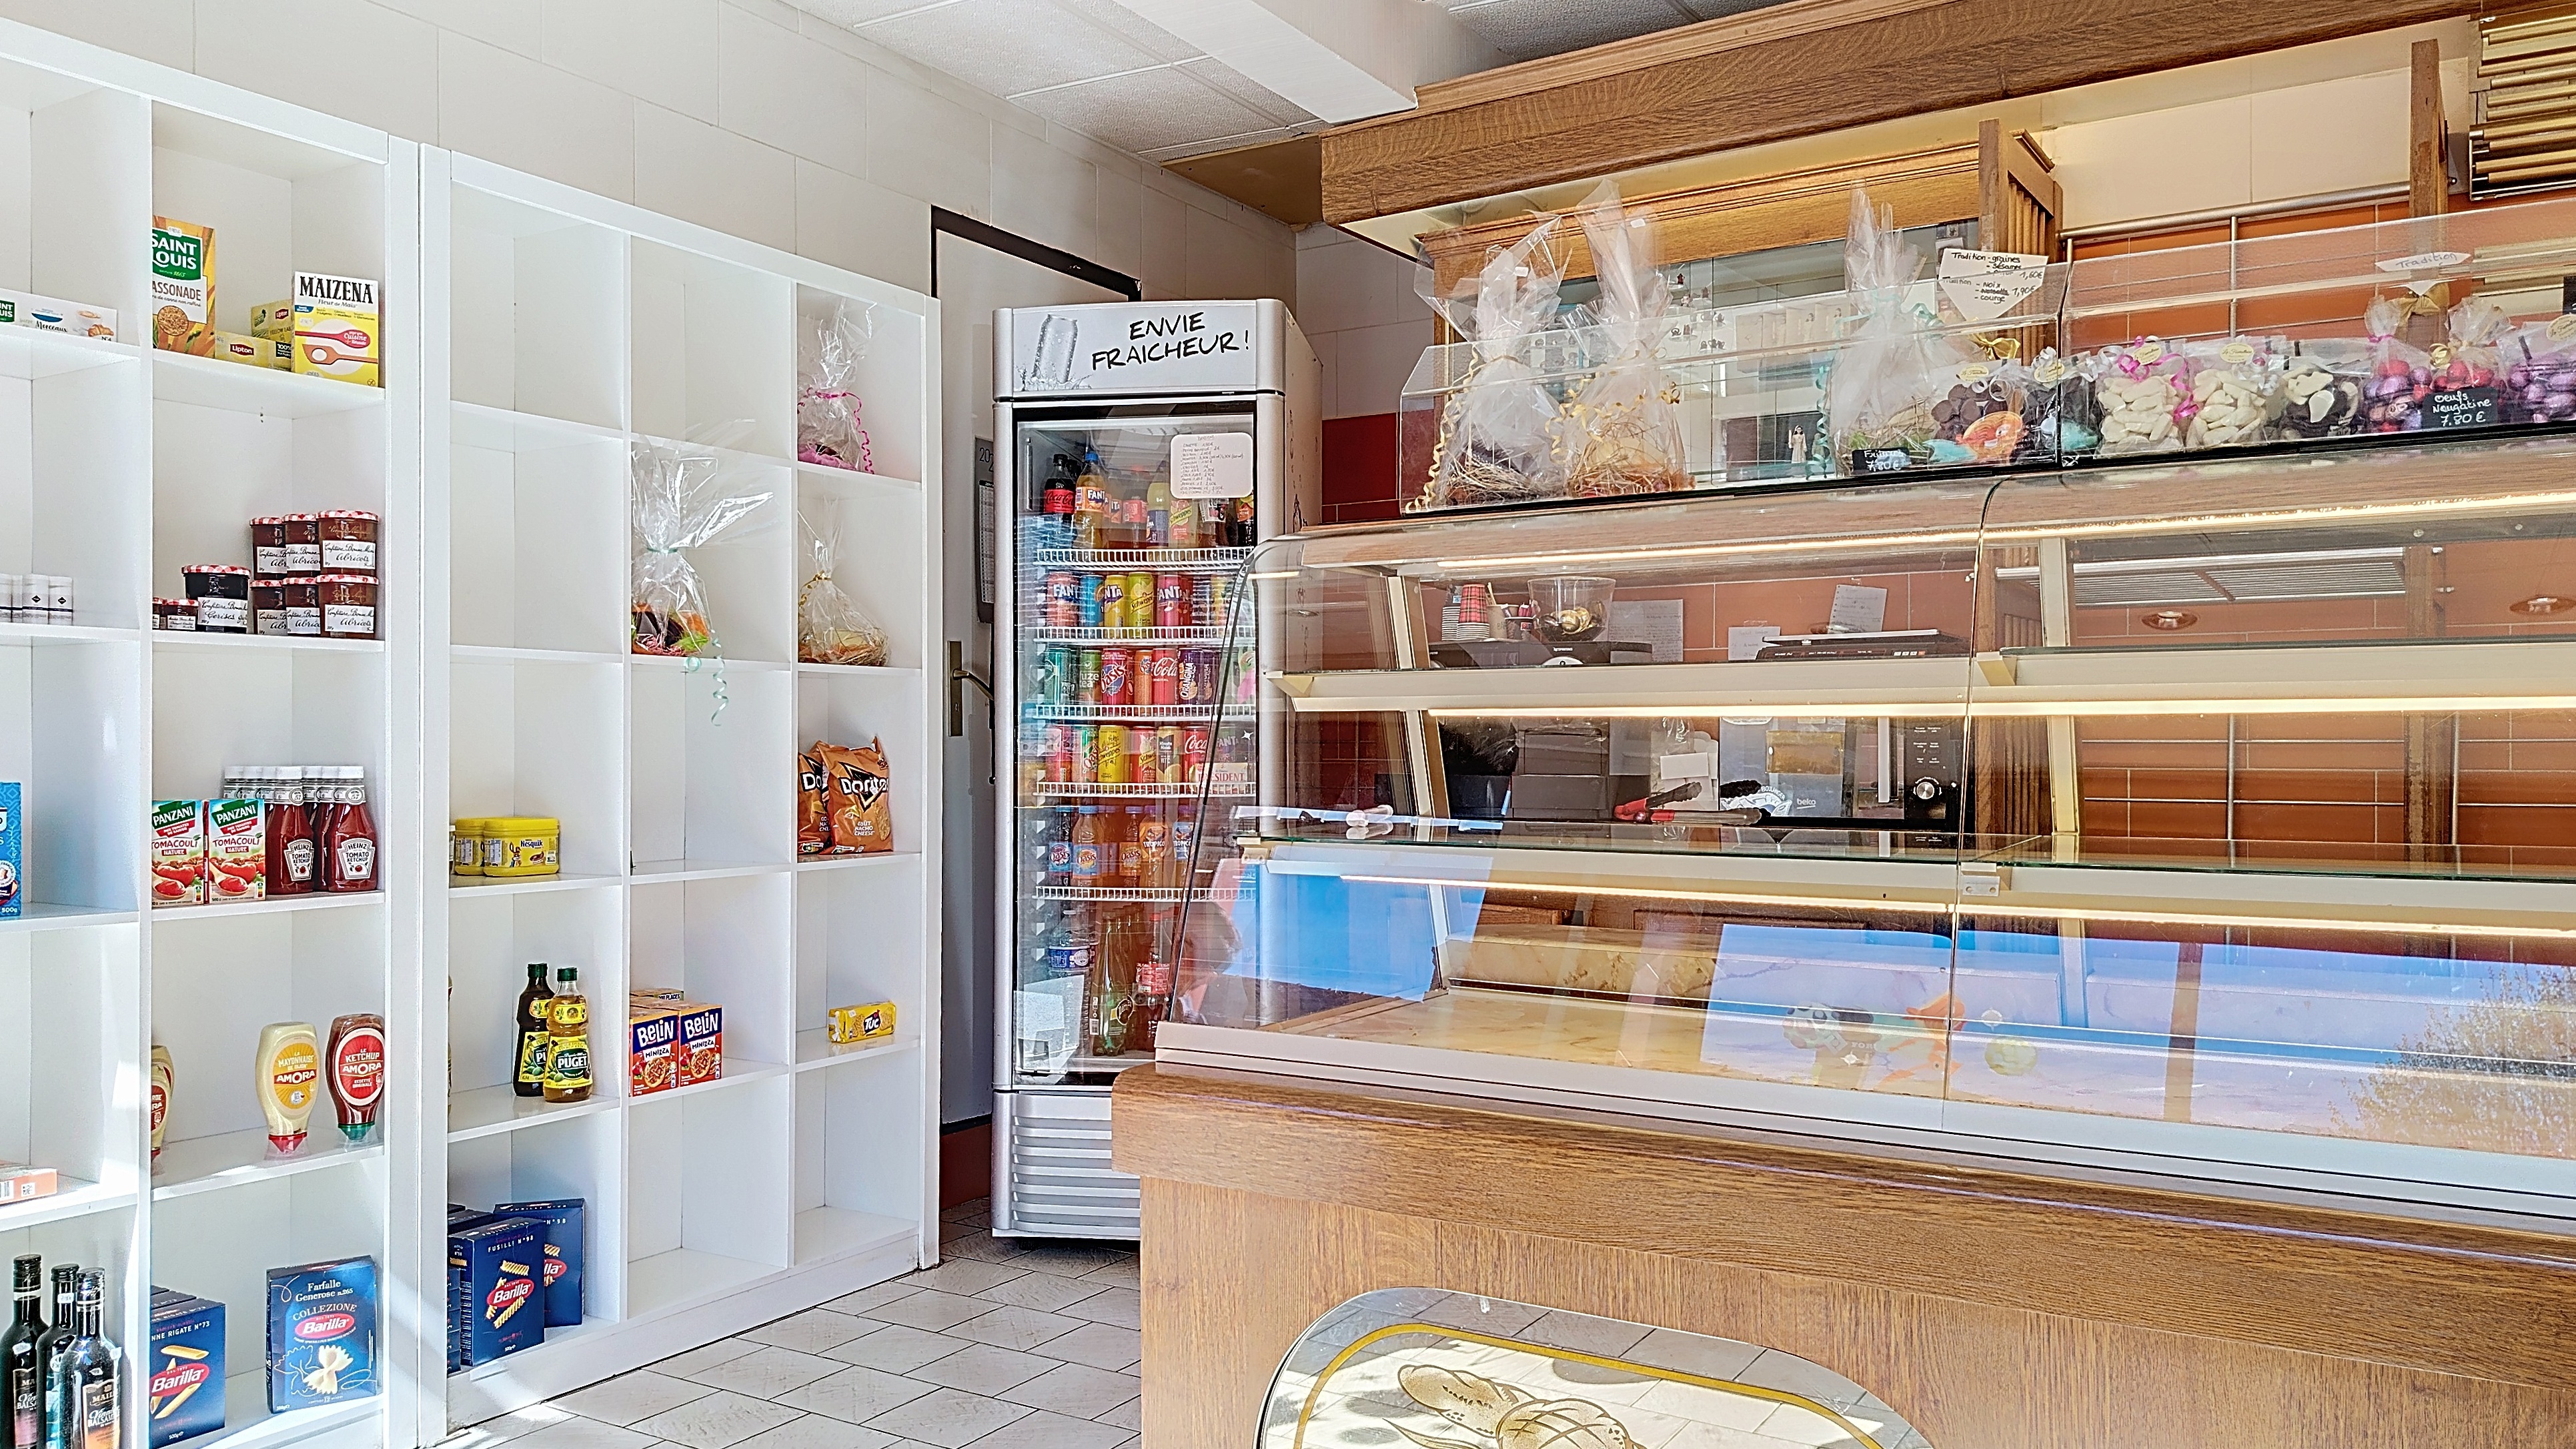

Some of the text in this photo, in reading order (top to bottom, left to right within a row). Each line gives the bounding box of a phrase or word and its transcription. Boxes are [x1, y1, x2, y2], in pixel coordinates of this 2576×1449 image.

[1951, 252, 1986, 260] Tradition
[2396, 253, 2457, 268] Tradition
[299, 276, 374, 304] MAIZENA
[1130, 312, 1205, 340] ENVIE
[232, 346, 252, 355] Lipton
[1092, 332, 1240, 370] FRAICHEUR
[153, 806, 193, 827] PANZANI
[217, 805, 256, 825] PANZANI
[213, 838, 259, 847] TOMACOULI
[521, 840, 543, 848] Nesquik
[692, 1039, 714, 1049] MINIZZA
[346, 1052, 380, 1063] KETCHUP
[645, 1047, 670, 1058] MINIZZA
[278, 1055, 314, 1067] MAYONNAISE
[558, 1056, 587, 1068] PUGET
[342, 1062, 382, 1075] AMORA
[276, 1070, 315, 1083] AMORA
[488, 1240, 514, 1253] FUSILLI
[307, 1280, 341, 1292] Farfalle
[295, 1290, 336, 1302] Generose
[494, 1284, 528, 1304] Barilla
[293, 1303, 357, 1321] COLLEZIONE
[167, 1325, 192, 1338] RIGATE
[194, 1320, 210, 1332] N°73
[303, 1318, 348, 1334] Barilla
[151, 1368, 202, 1394] Barilla
